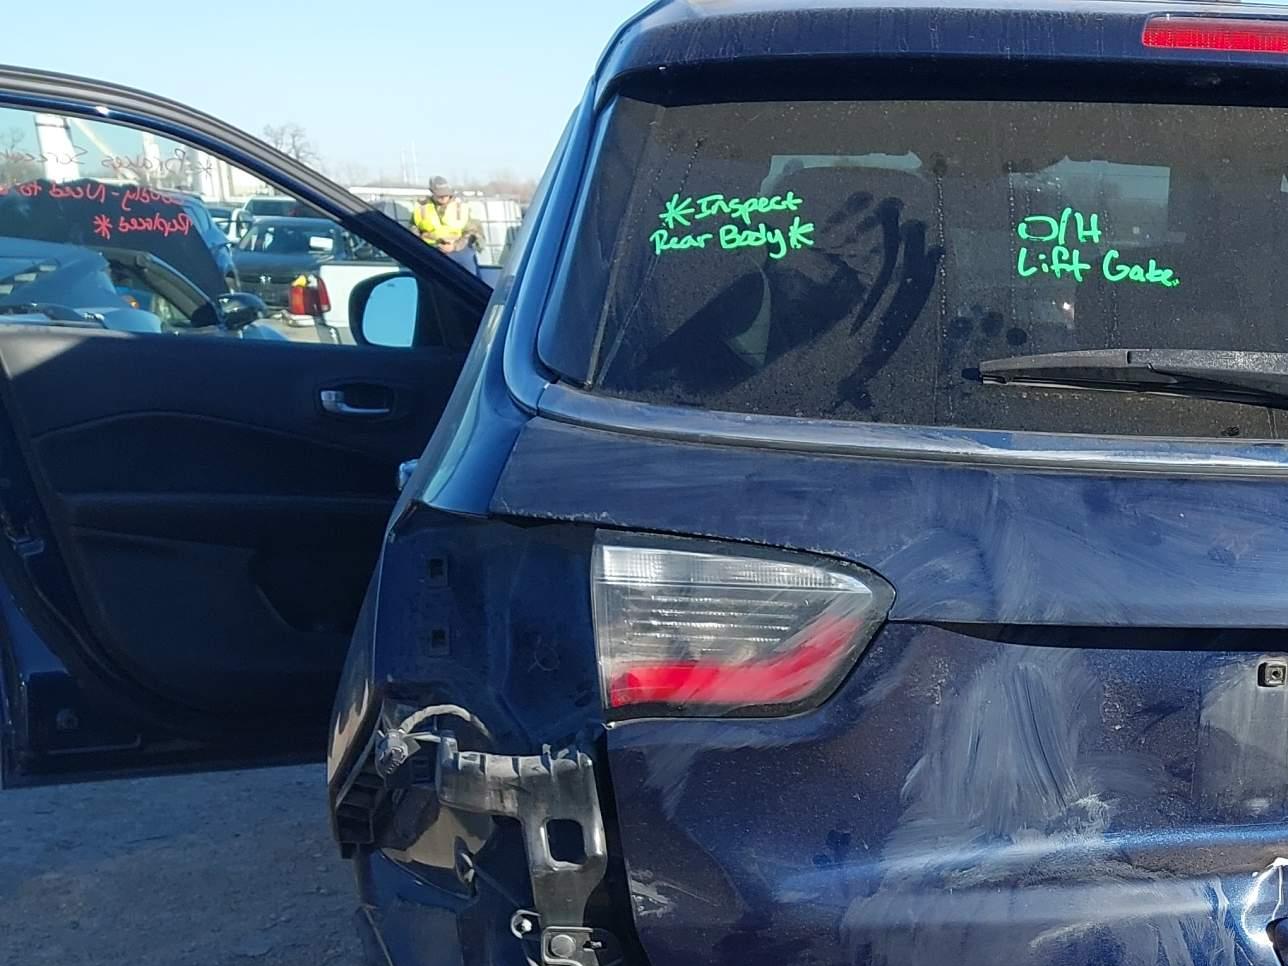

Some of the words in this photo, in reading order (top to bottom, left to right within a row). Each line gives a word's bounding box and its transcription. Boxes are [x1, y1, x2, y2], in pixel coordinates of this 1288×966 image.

[650, 229, 713, 255] Rear
[1018, 207, 1101, 245] O/H
[1018, 246, 1091, 282] Lift
